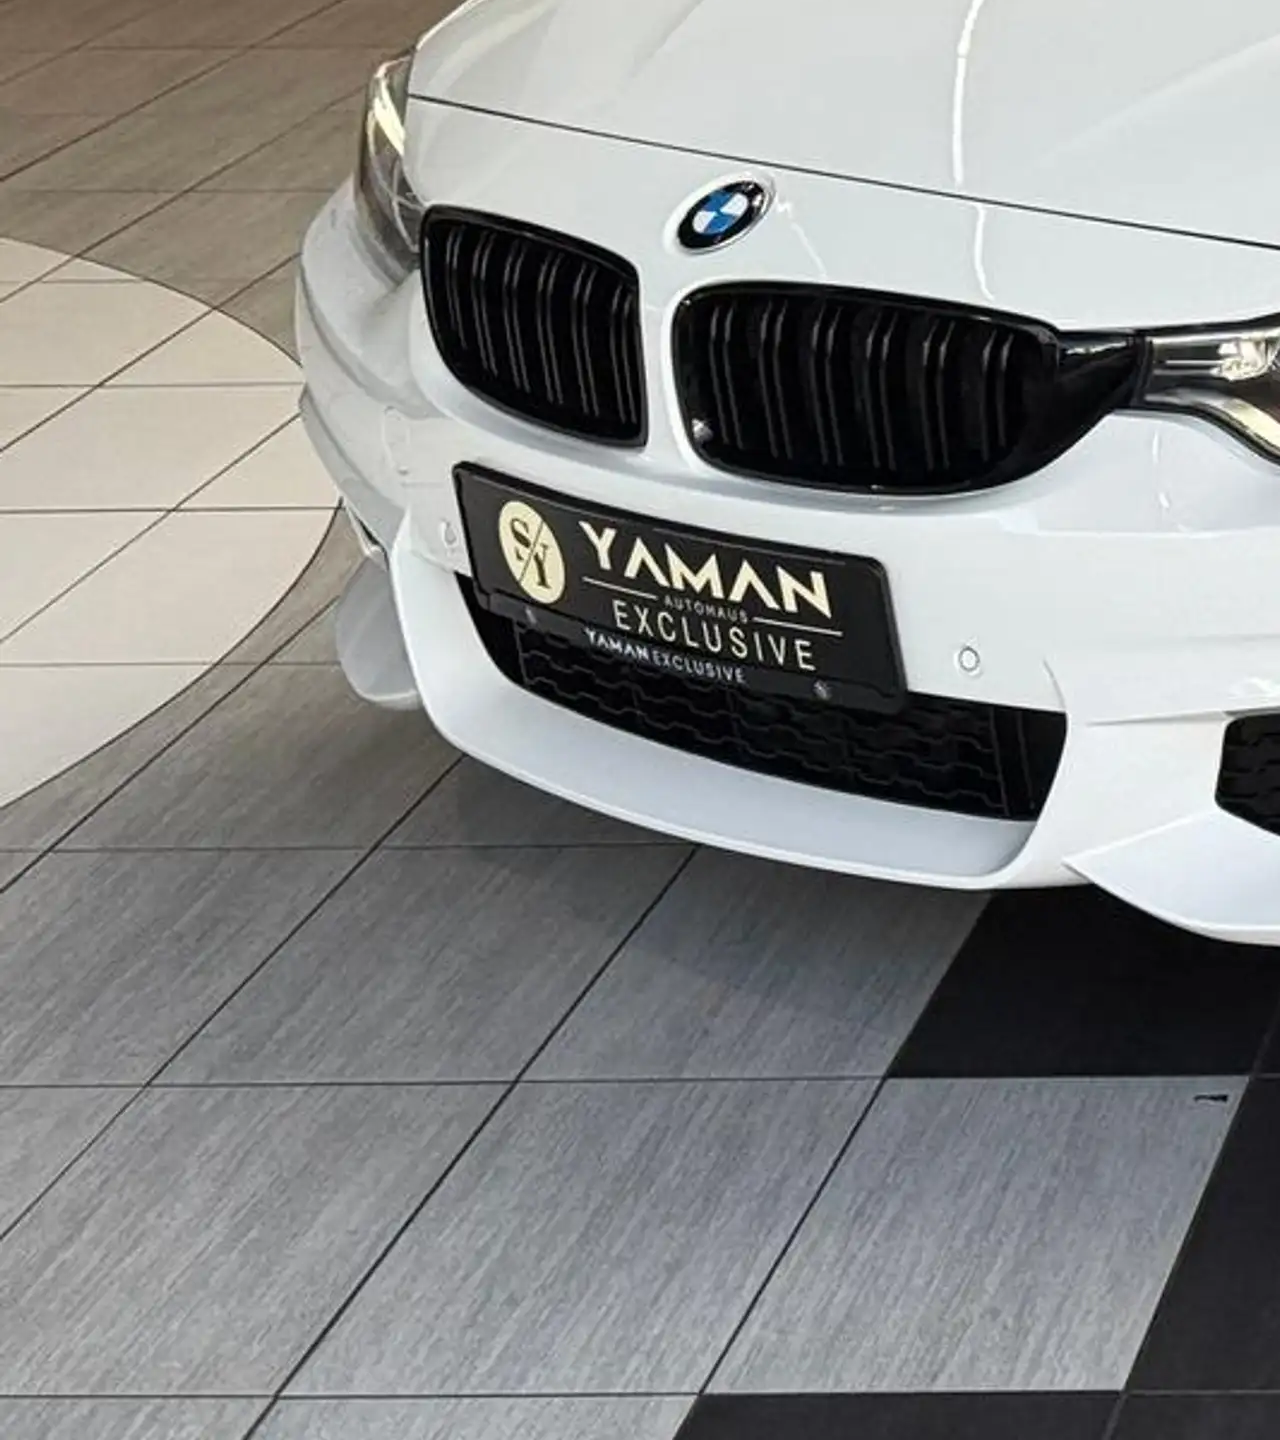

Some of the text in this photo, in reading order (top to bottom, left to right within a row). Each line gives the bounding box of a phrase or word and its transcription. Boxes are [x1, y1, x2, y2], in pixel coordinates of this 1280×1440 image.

[577, 520, 832, 619] YAMAN
[612, 599, 816, 671] EXCLUSIVE
[663, 594, 749, 624] AUTOHAUS
[584, 626, 747, 684] YAMAN EXCLUSIVE
